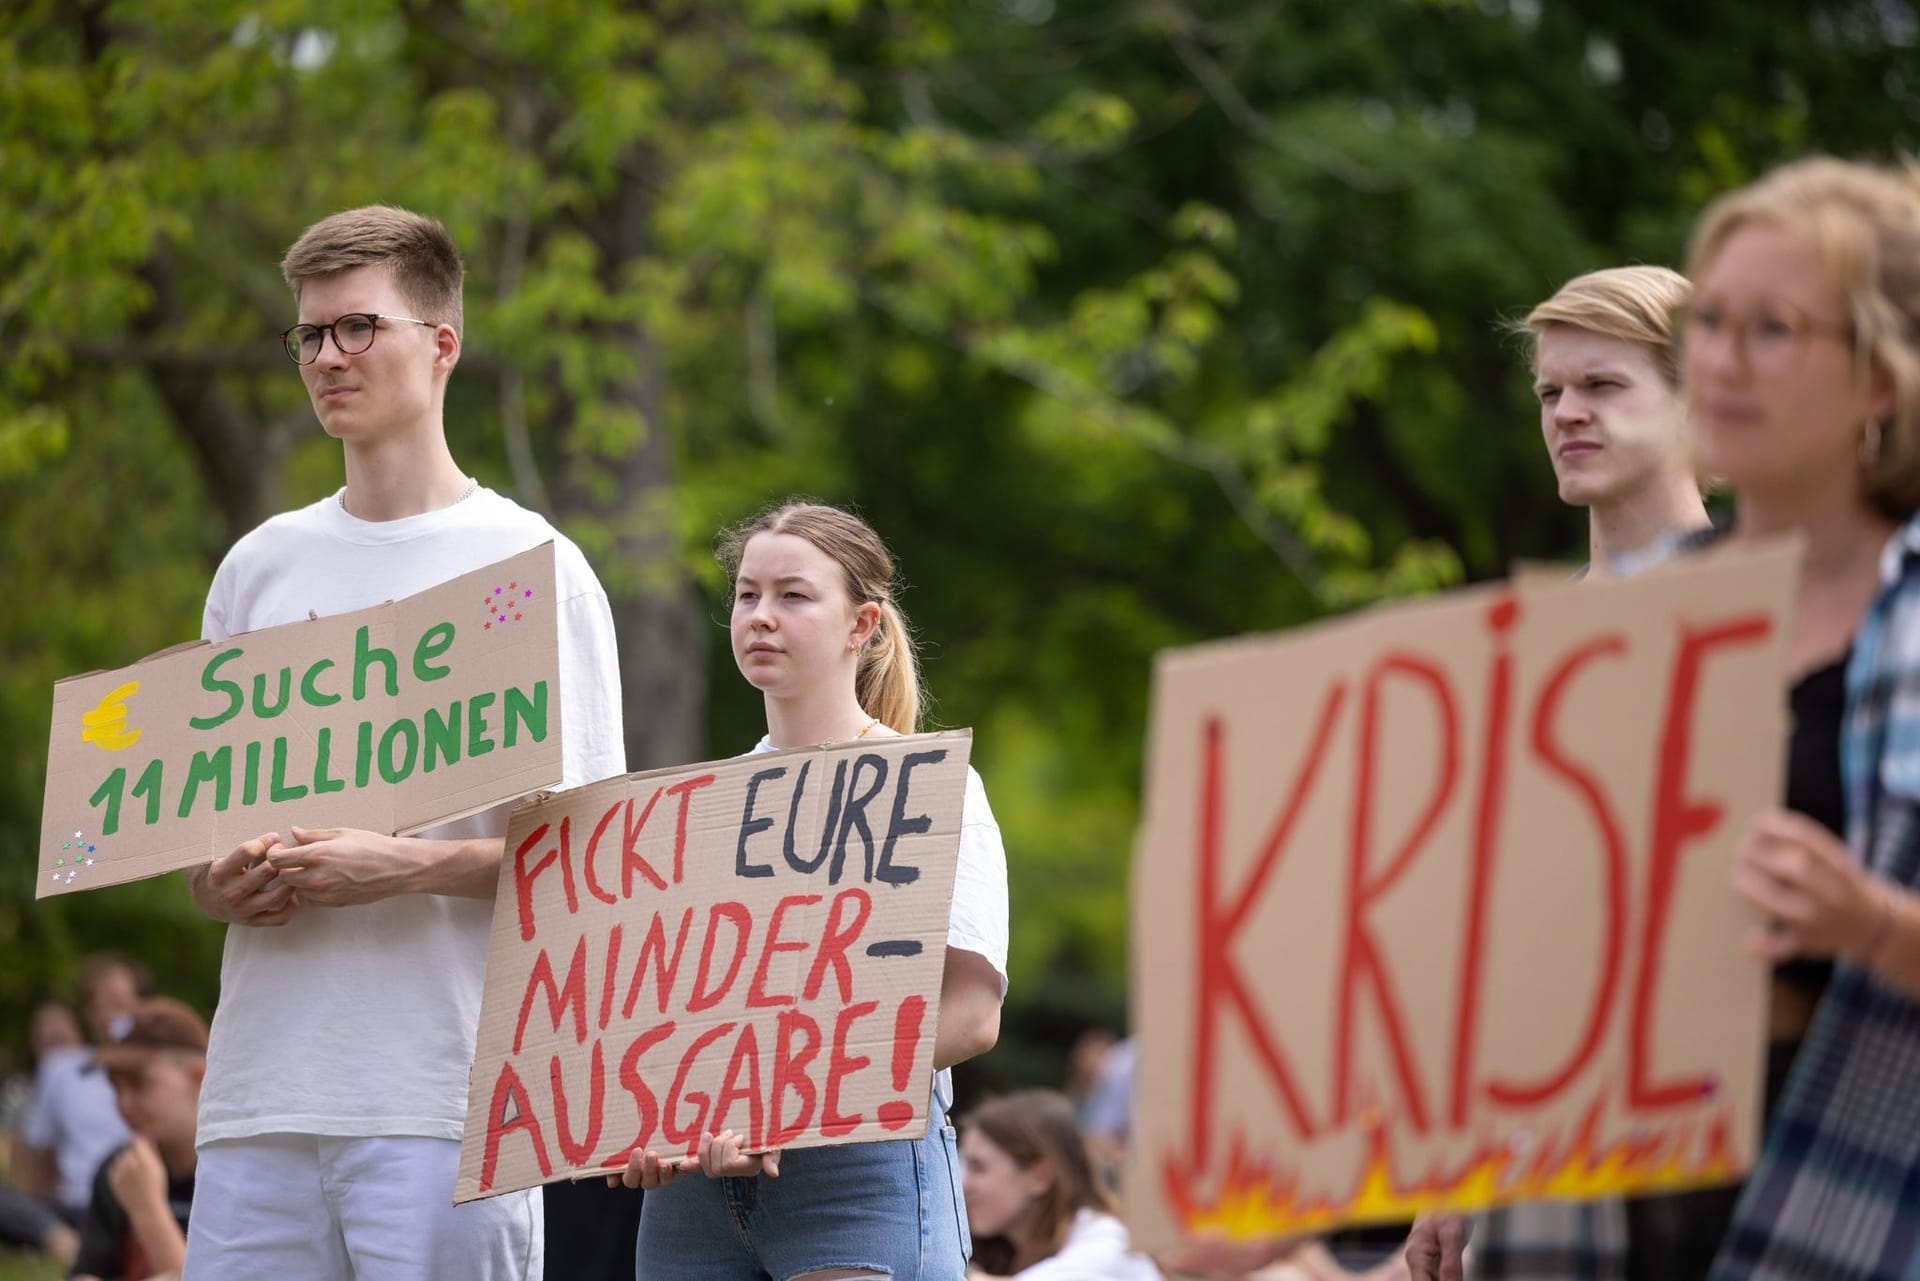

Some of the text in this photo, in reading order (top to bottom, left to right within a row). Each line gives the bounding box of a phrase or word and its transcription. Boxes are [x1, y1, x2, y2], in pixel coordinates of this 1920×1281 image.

[177, 680, 549, 818] MILLIONEN
[189, 622, 456, 729] Suche
[514, 750, 947, 941] FICKT EURE
[512, 888, 924, 1055] MINDER-
[479, 995, 927, 1193] AUSGABE!
